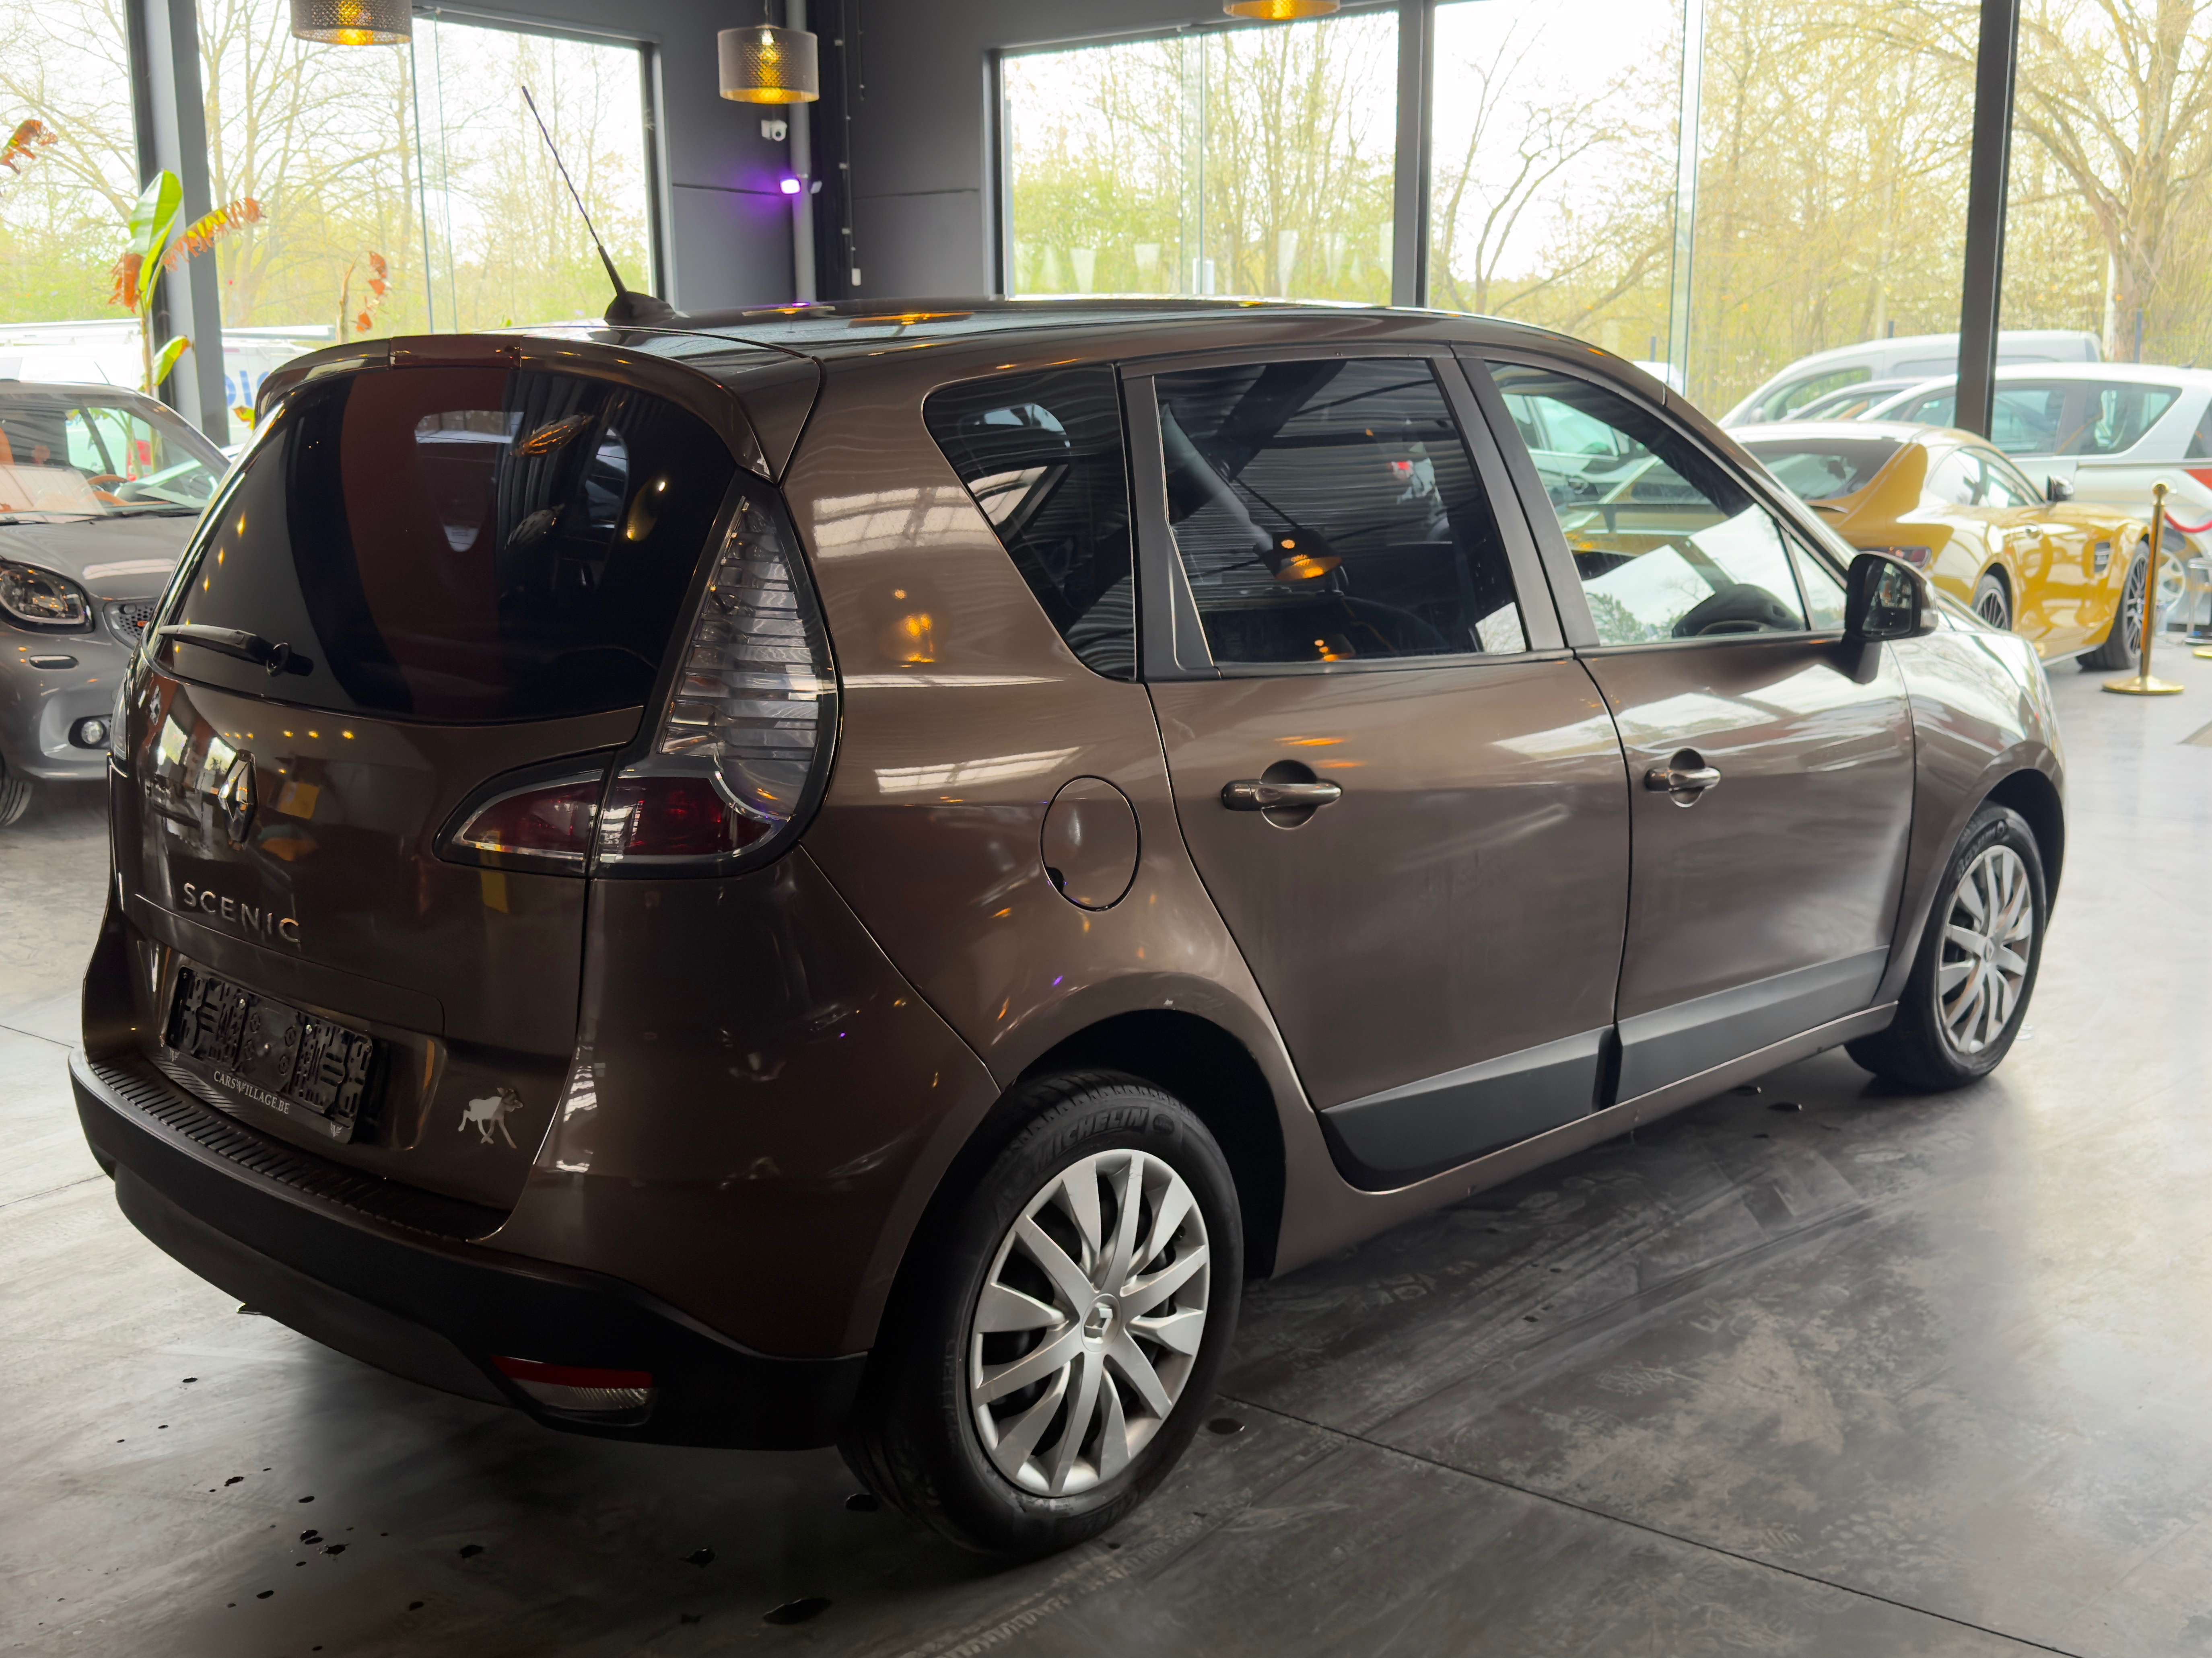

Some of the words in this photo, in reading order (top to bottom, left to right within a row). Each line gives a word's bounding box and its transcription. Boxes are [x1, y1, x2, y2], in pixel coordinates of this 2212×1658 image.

[183, 882, 301, 943] SCENIC
[213, 1070, 290, 1115] CARSVILLAGE.BE
[1036, 1107, 1149, 1168] MICHELIN
